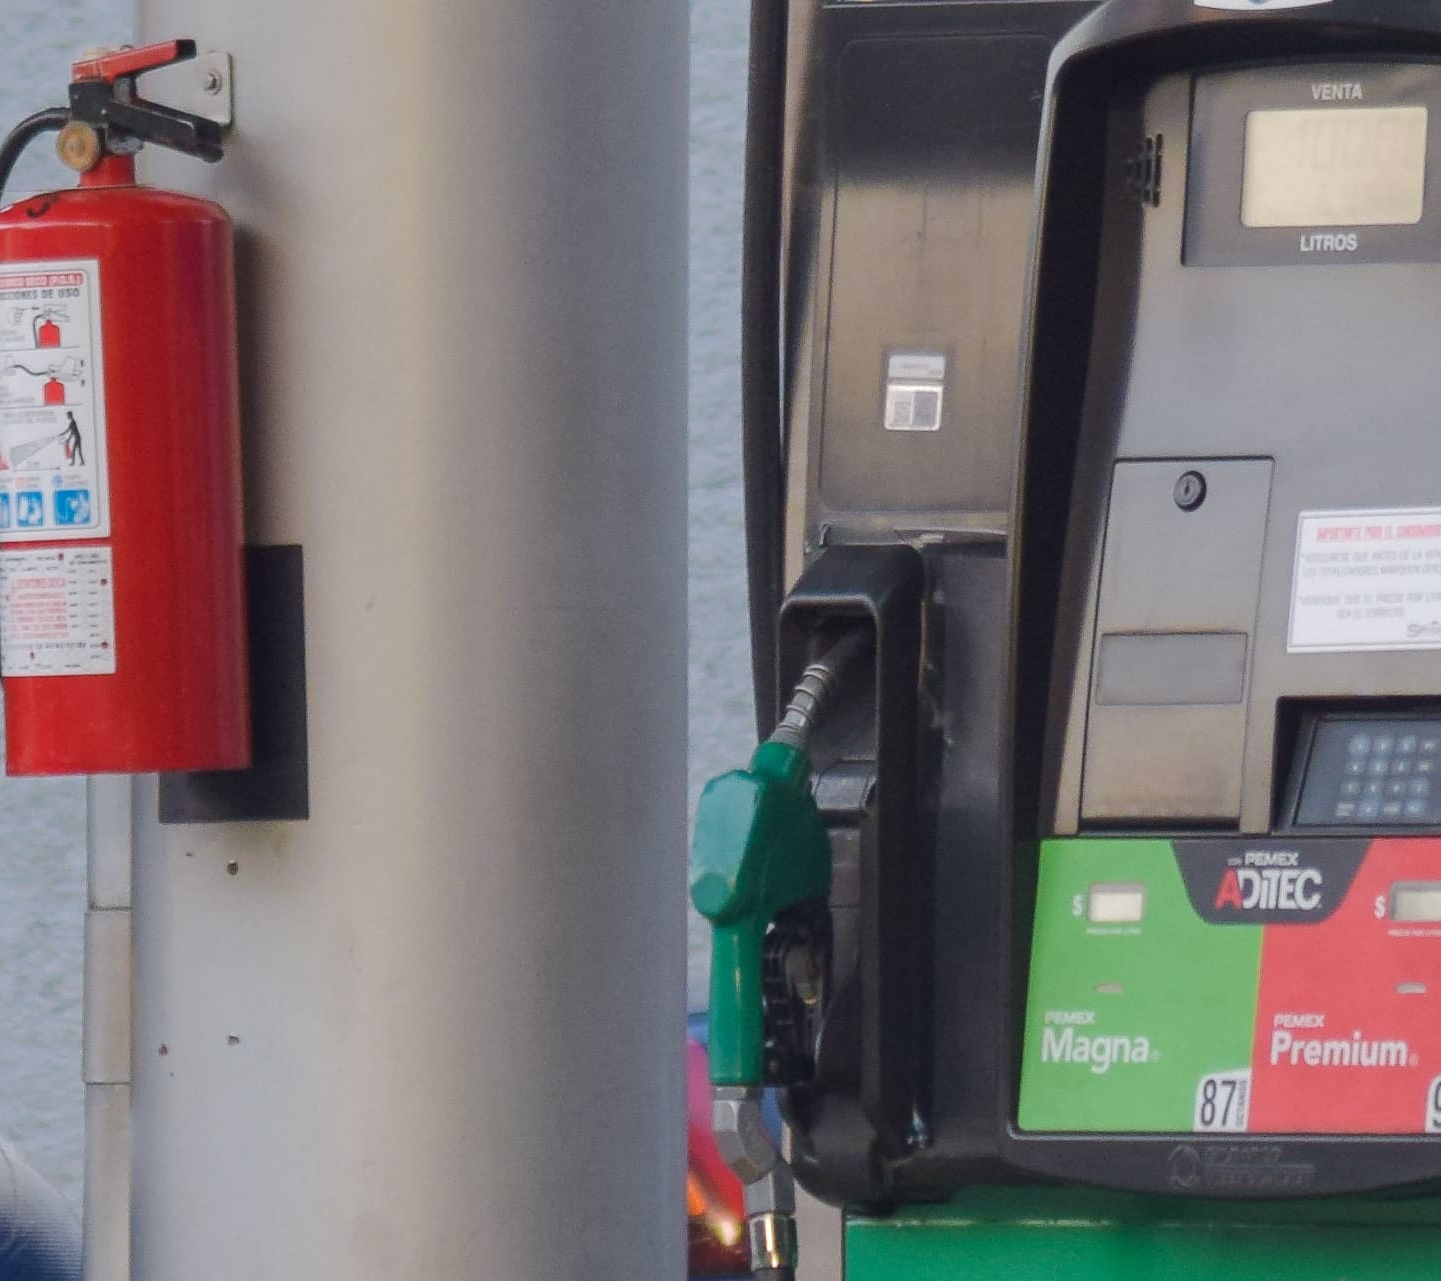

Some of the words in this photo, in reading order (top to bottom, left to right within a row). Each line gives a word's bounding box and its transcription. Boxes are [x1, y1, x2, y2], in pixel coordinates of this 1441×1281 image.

[1311, 83, 1363, 102] VENTA
[1300, 233, 1358, 253] LITROS
[1244, 851, 1300, 868] PEMEX
[1071, 894, 1084, 917] $
[1374, 896, 1386, 919] $
[1044, 1011, 1095, 1025] PEMEX
[1274, 1013, 1325, 1028] PEMEX
[1041, 1027, 1150, 1074] Magna
[1270, 1029, 1408, 1067] Premium
[1200, 1078, 1237, 1128] 87
